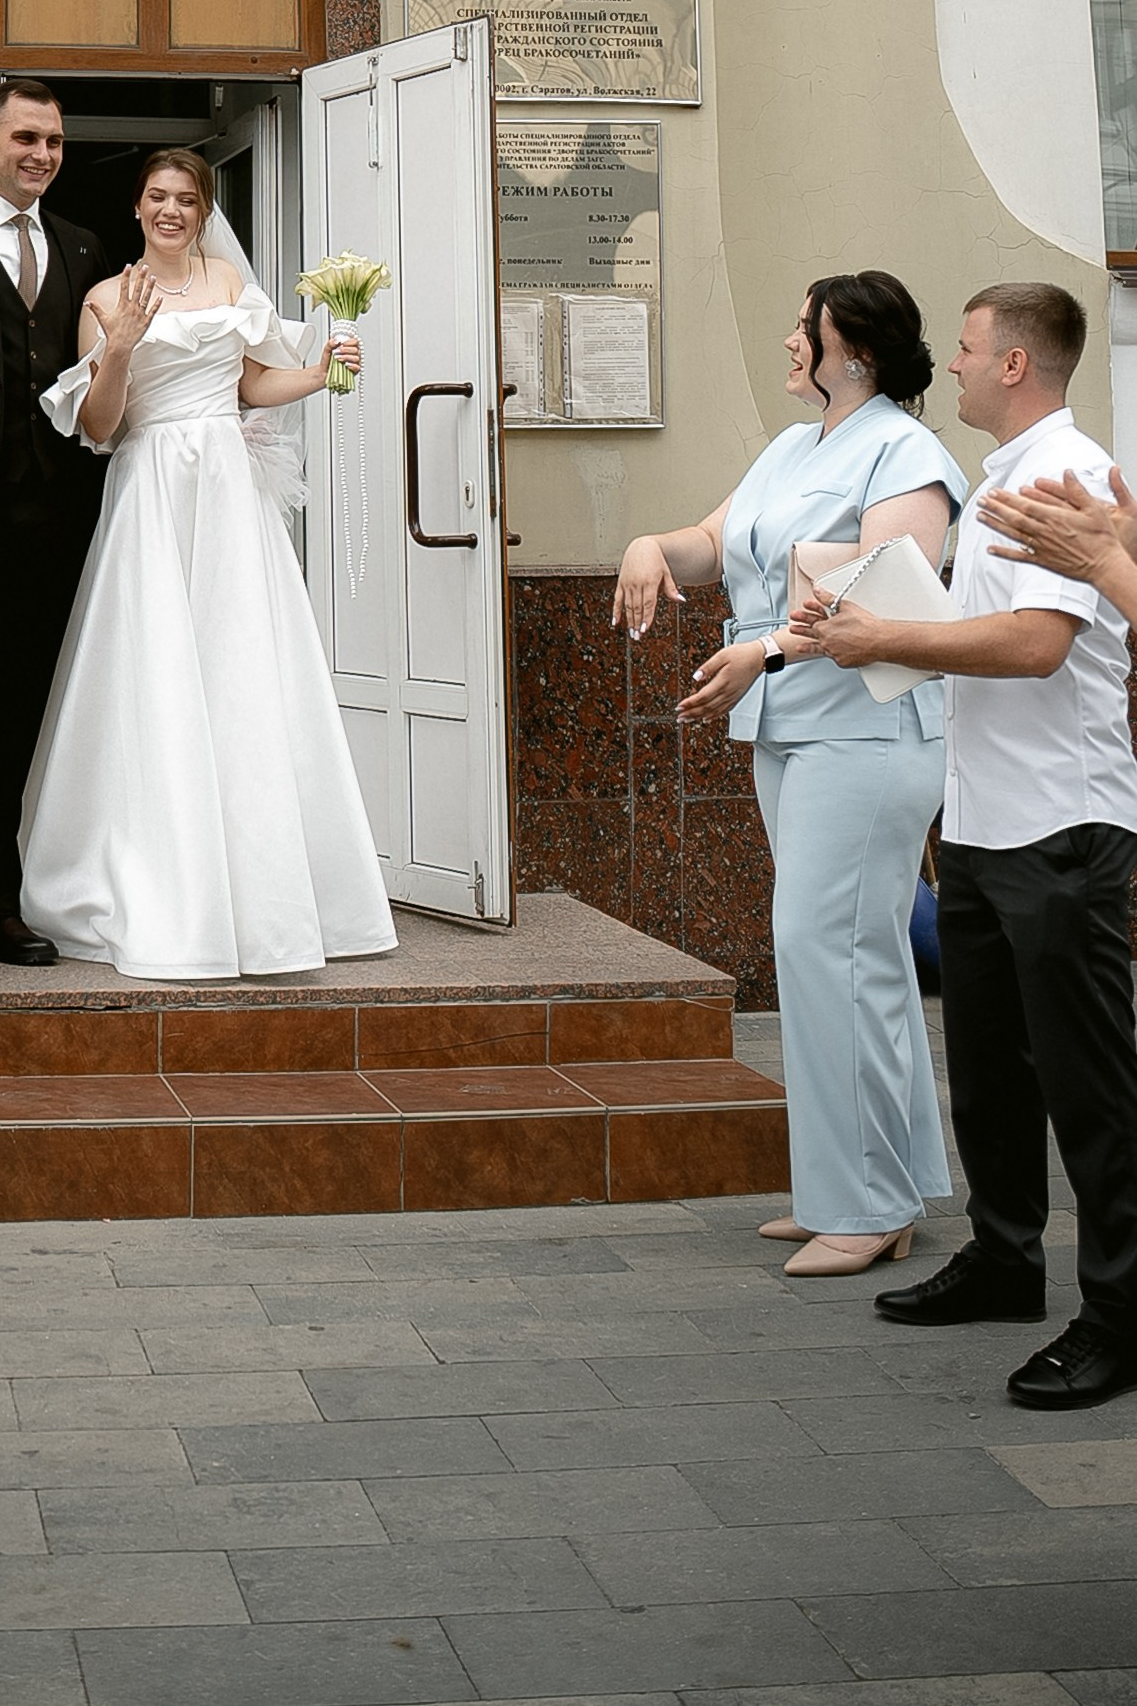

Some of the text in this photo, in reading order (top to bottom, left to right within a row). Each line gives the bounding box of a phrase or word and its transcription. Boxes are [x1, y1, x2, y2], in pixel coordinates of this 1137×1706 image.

[609, 12, 648, 23] ОТДЕЛ
[573, 23, 658, 36] РЕГИСТРАЦИИ
[589, 37, 663, 48] СОСТОЯНИЯ
[523, 48, 641, 60] БРАКОСОЧЕТАНИЙ»
[531, 84, 574, 95] Саратов,
[593, 86, 643, 96] Волжская,
[646, 87, 657, 96] 22
[553, 186, 614, 198] РАБОТЫ
[588, 214, 630, 223] 8.30-17.30
[588, 236, 633, 244] 13.00-14.00
[589, 257, 633, 266] Выходные
[635, 259, 651, 267] дни
